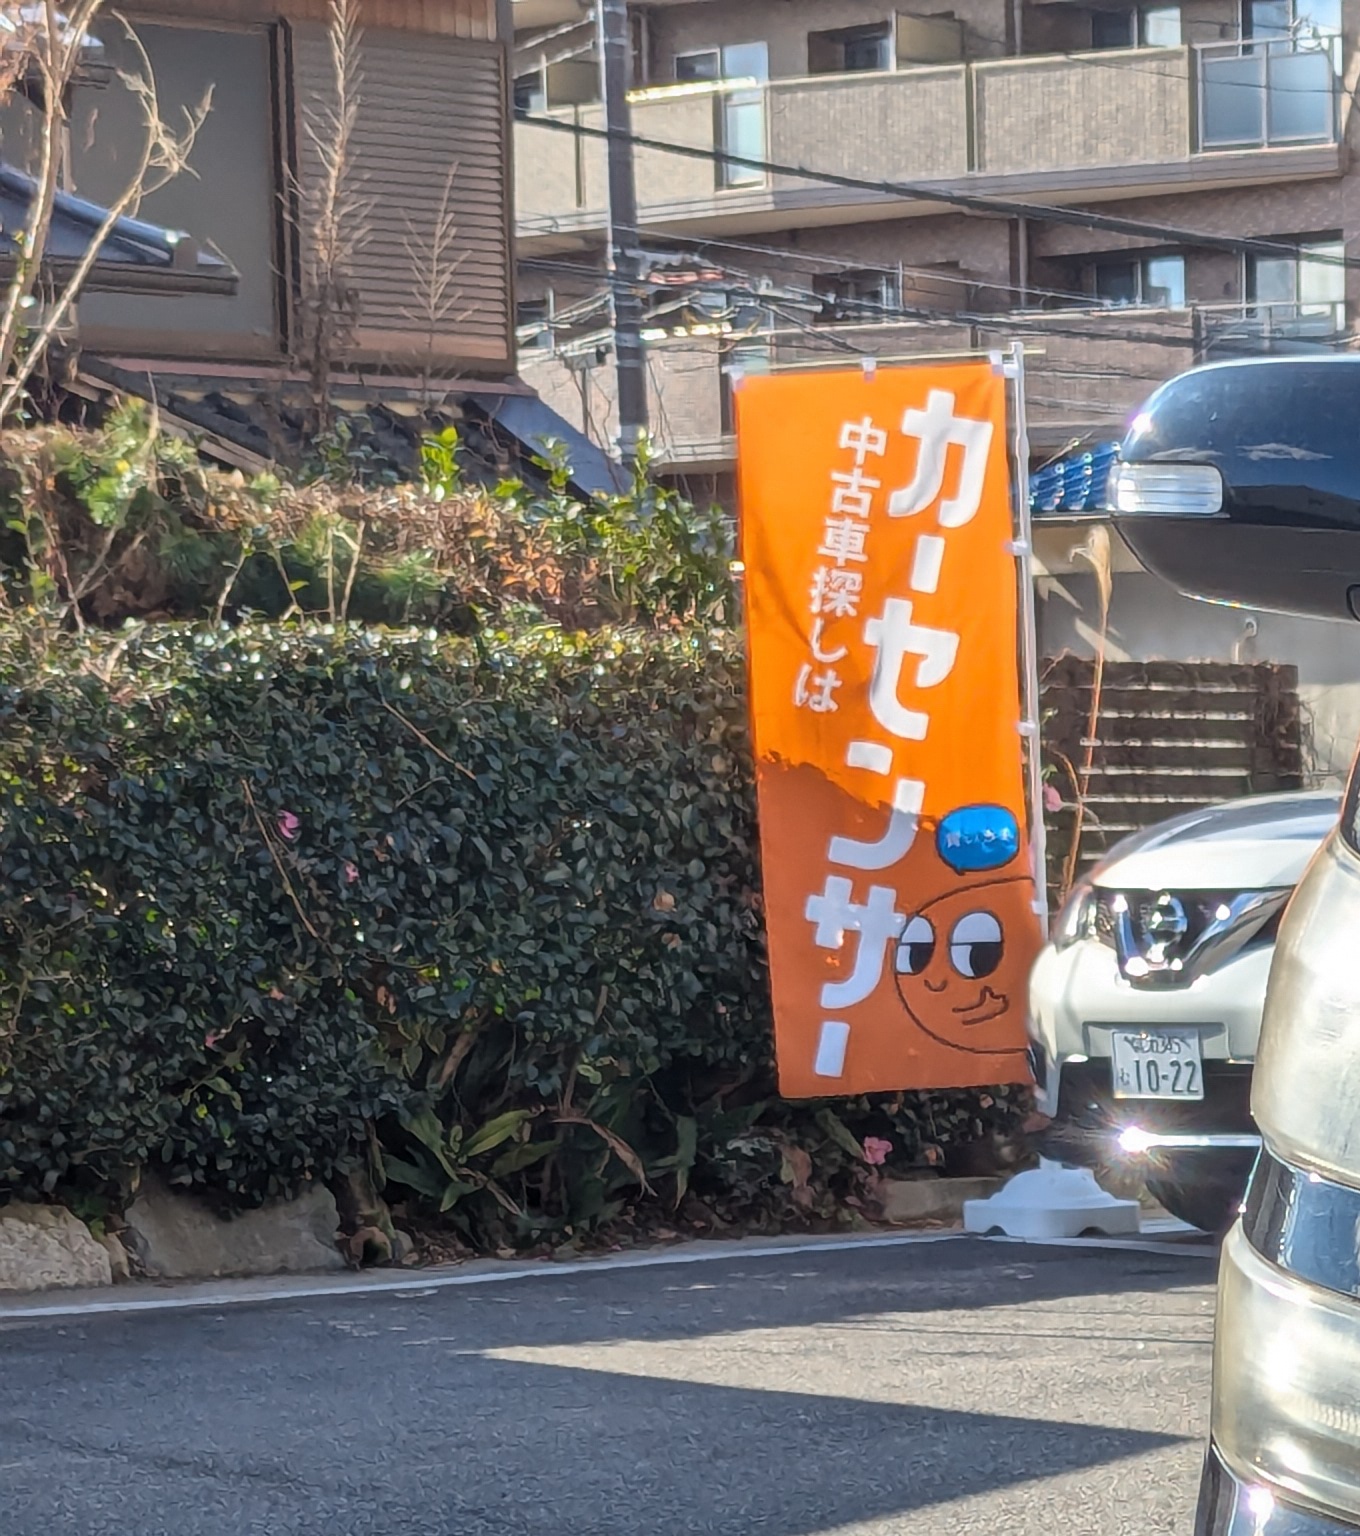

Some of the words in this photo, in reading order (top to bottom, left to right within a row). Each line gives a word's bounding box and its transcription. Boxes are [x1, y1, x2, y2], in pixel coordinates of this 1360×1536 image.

[793, 416, 887, 713] 中古車探しは
[805, 389, 993, 1077] カーセンサー
[1133, 1059, 1199, 1093] 10-22
